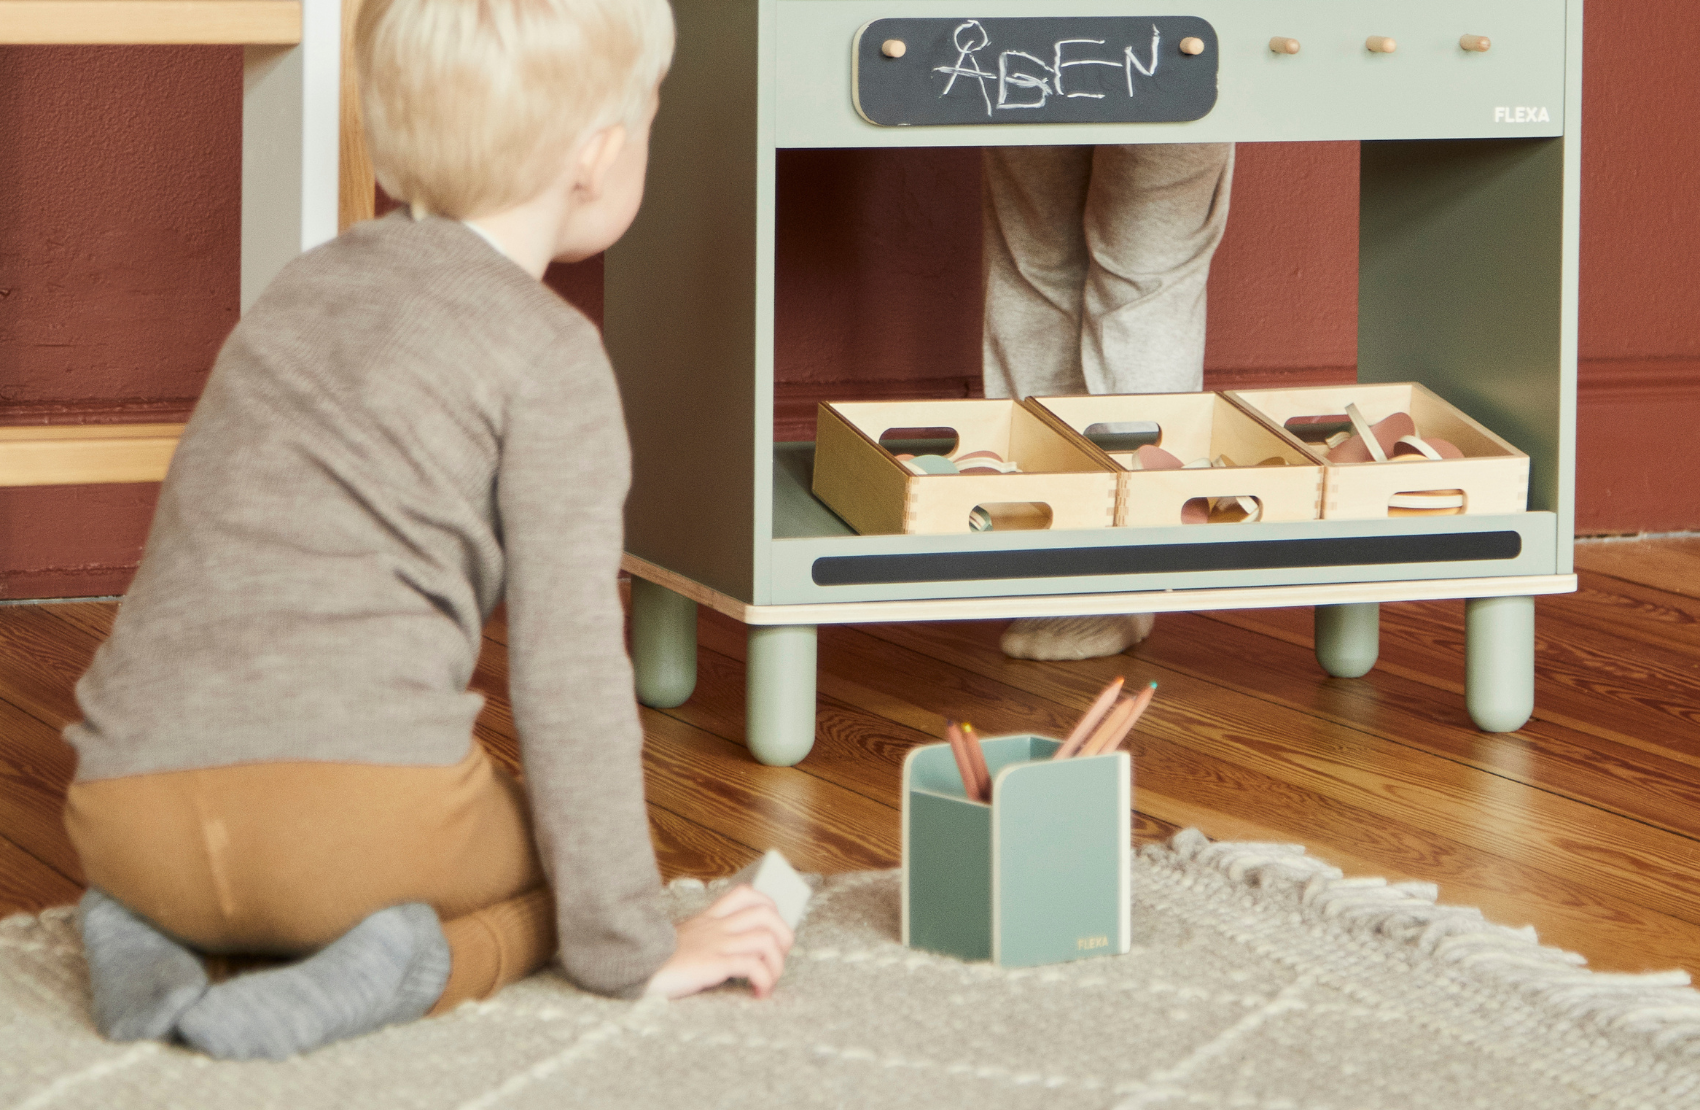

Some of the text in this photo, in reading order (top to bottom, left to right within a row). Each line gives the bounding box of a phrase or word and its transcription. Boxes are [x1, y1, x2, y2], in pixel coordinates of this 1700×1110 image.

[931, 19, 1160, 117] ÅBEN
[1494, 106, 1550, 123] FLEXA
[1077, 935, 1109, 950] FLEXA
